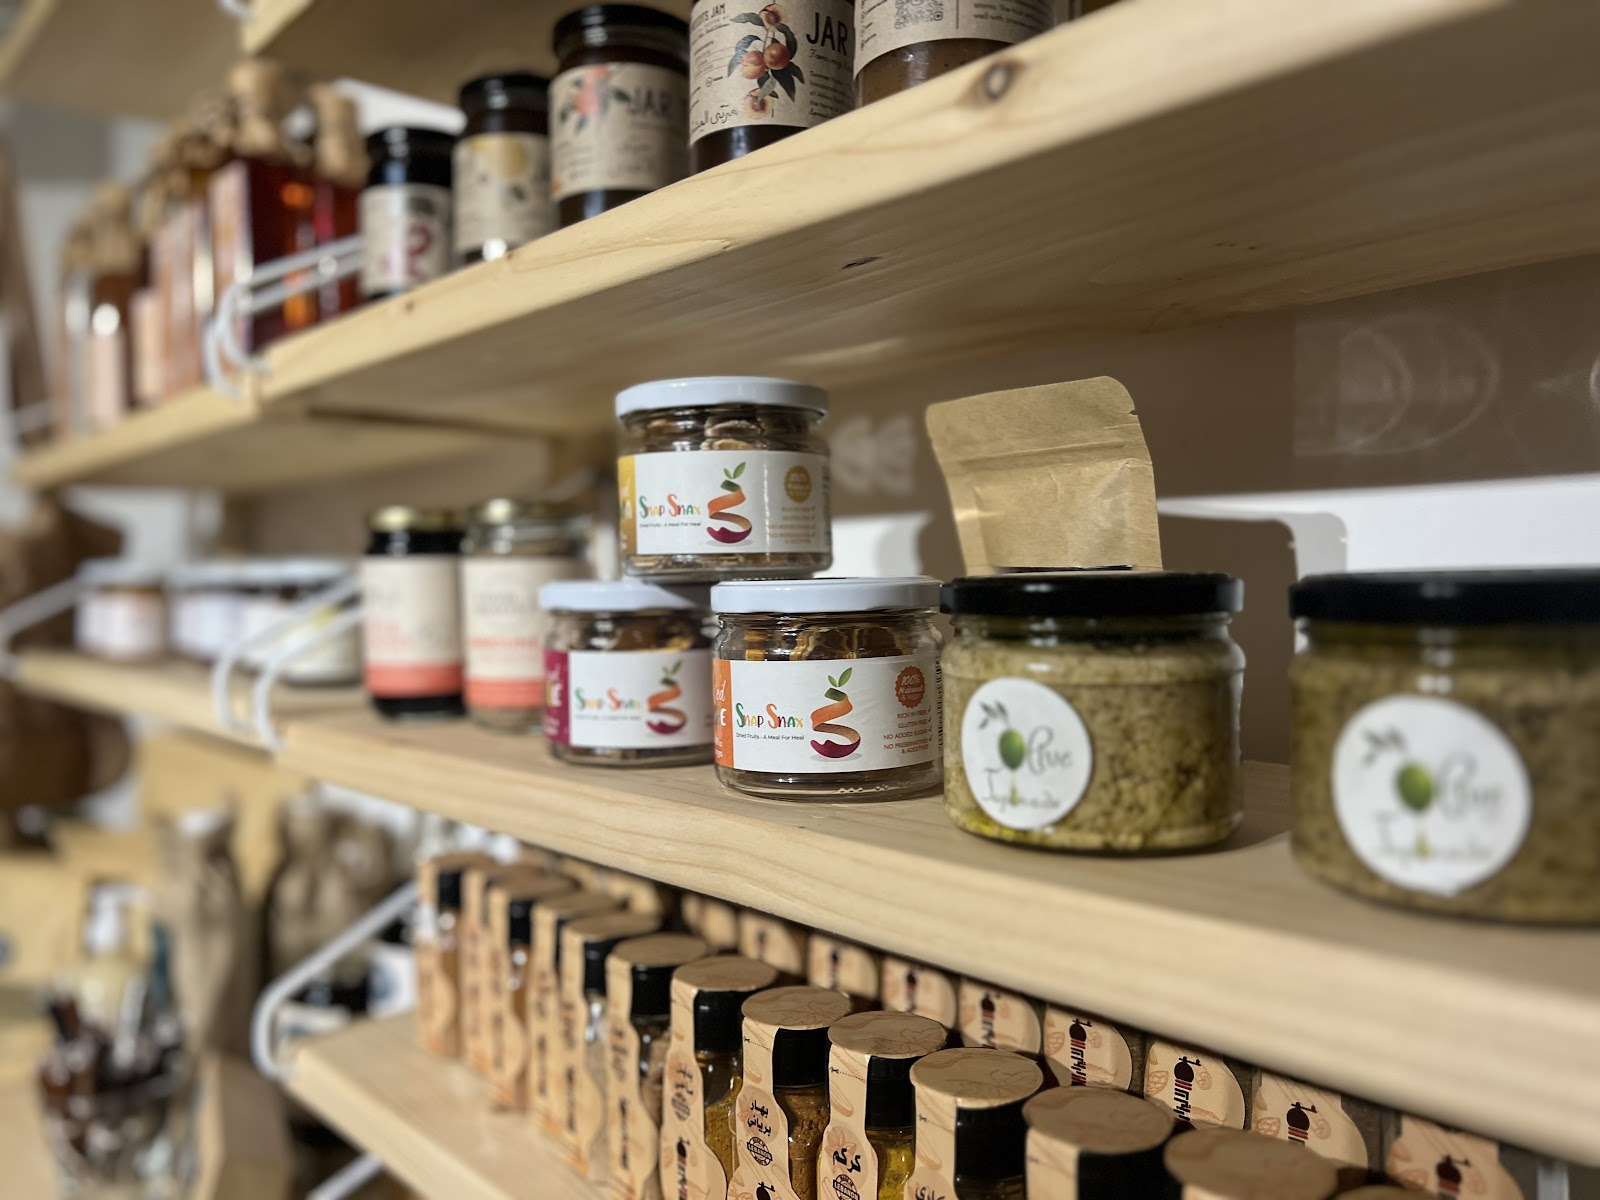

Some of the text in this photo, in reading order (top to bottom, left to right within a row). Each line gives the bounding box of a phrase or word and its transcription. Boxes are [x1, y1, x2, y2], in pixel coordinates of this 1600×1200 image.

[806, 12, 848, 56] JAR
[895, 731, 913, 739] ADDED
[747, 1142, 773, 1161] LEBANON
[833, 1180, 860, 1199] LEBANON
